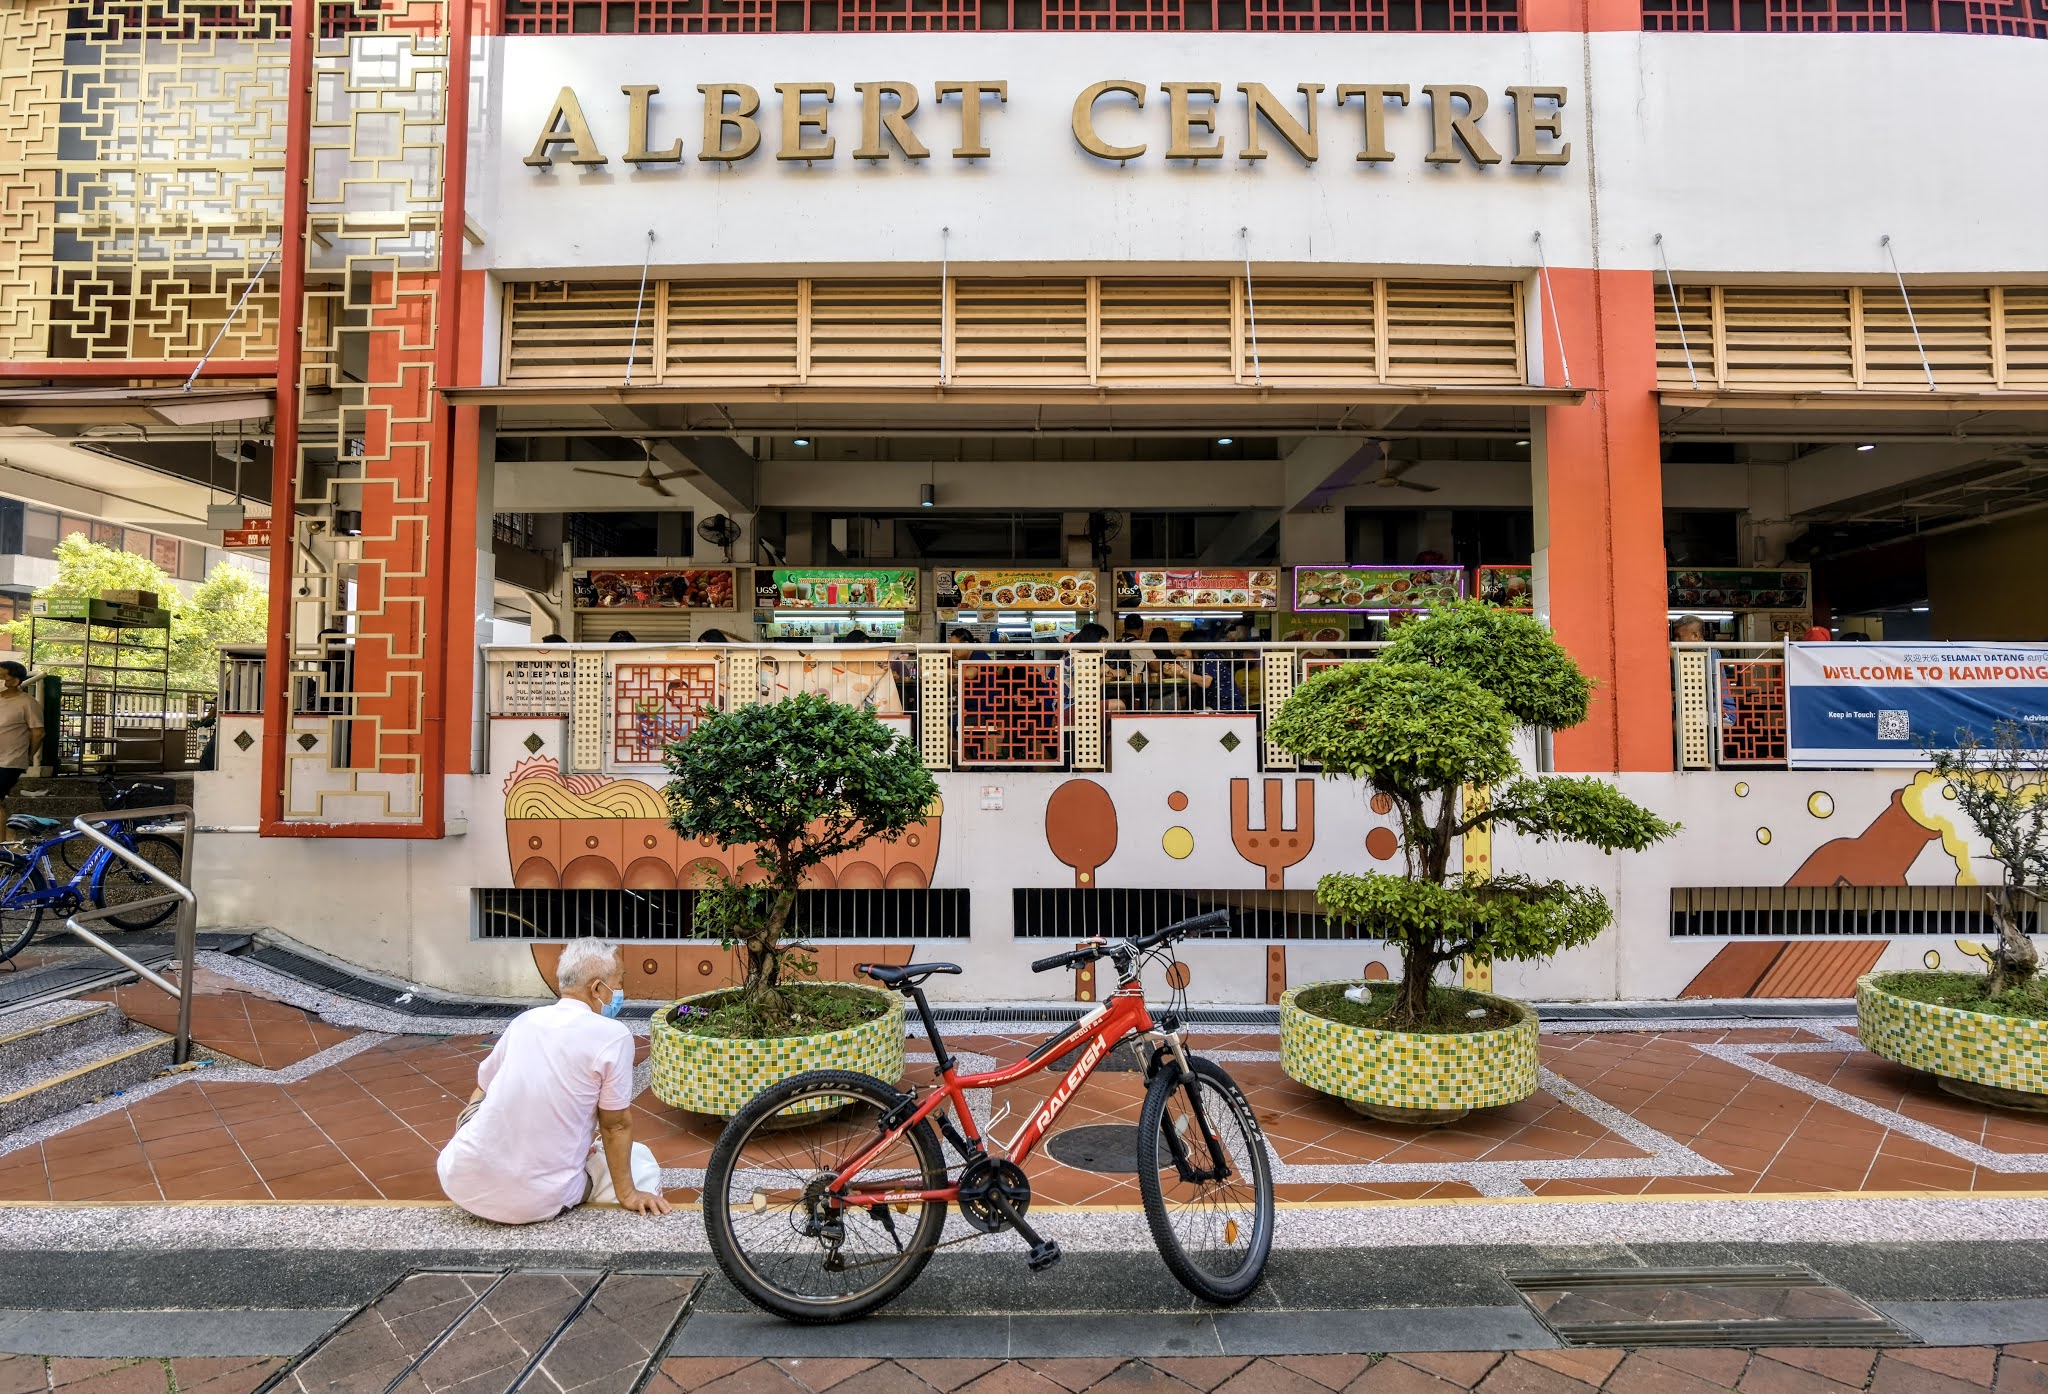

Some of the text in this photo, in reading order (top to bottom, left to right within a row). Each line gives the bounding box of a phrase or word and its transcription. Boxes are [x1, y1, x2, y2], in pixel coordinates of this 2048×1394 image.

[522, 79, 1571, 166] ALBERT CENTRE
[574, 586, 592, 595] UGS
[756, 586, 774, 594] UGS
[1117, 587, 1136, 595] UGS
[1482, 585, 1499, 593] UGS
[1903, 653, 1940, 663] 欢迎光临
[1941, 654, 2025, 662] SELAMAT DATANG
[1823, 665, 2048, 681] WELCOME TO KAMPONG
[1828, 711, 1845, 719] Keep
[1069, 1018, 1103, 1043] SCOUT 24
[1036, 1033, 1107, 1134] RALEIGH
[790, 1082, 864, 1097] KENDA
[1228, 1086, 1262, 1142] KENDA
[883, 1192, 922, 1201] RALEIGH
